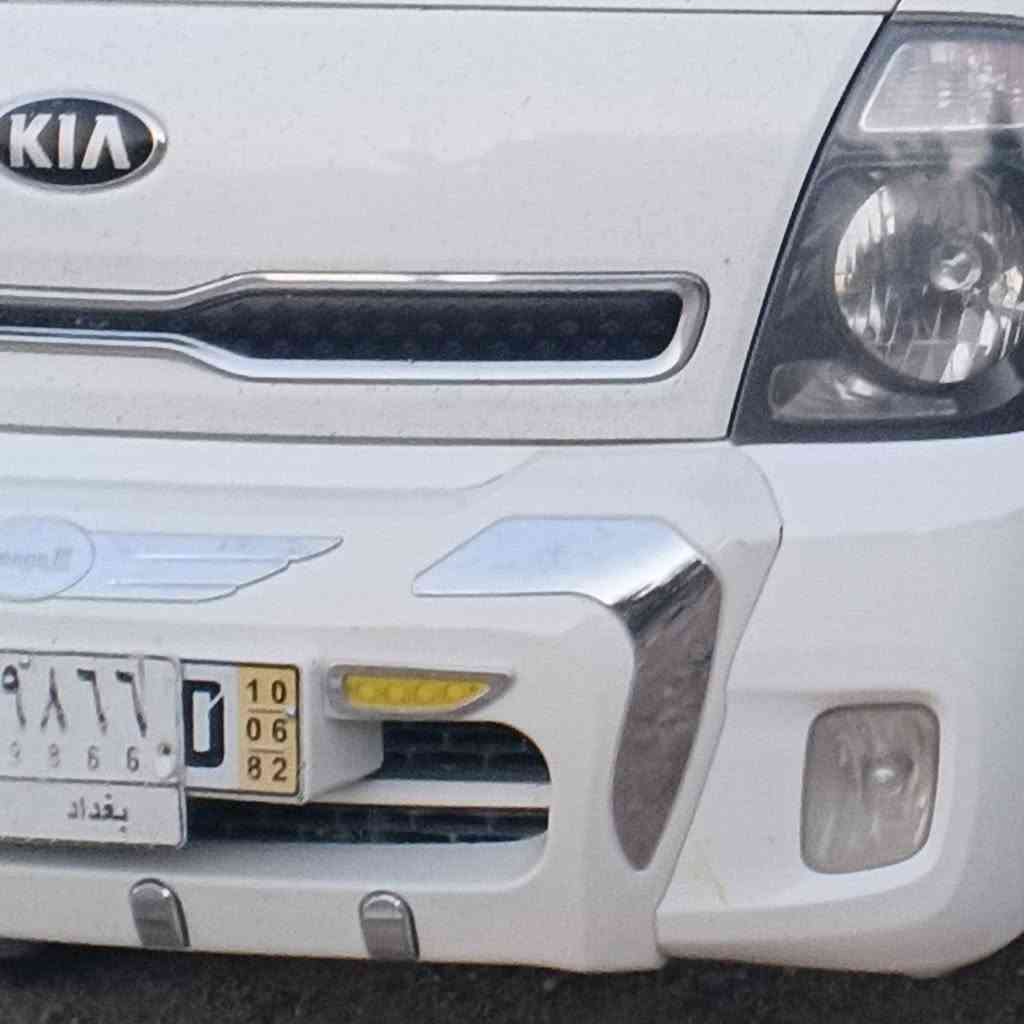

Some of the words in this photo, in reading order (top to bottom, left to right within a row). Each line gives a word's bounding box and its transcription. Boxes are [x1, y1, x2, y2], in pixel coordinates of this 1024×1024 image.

[8, 112, 132, 171] KIA
[246, 678, 287, 704] 10
[246, 716, 288, 743] 06
[247, 755, 288, 782] 82
[66, 792, 129, 833] بغداد
